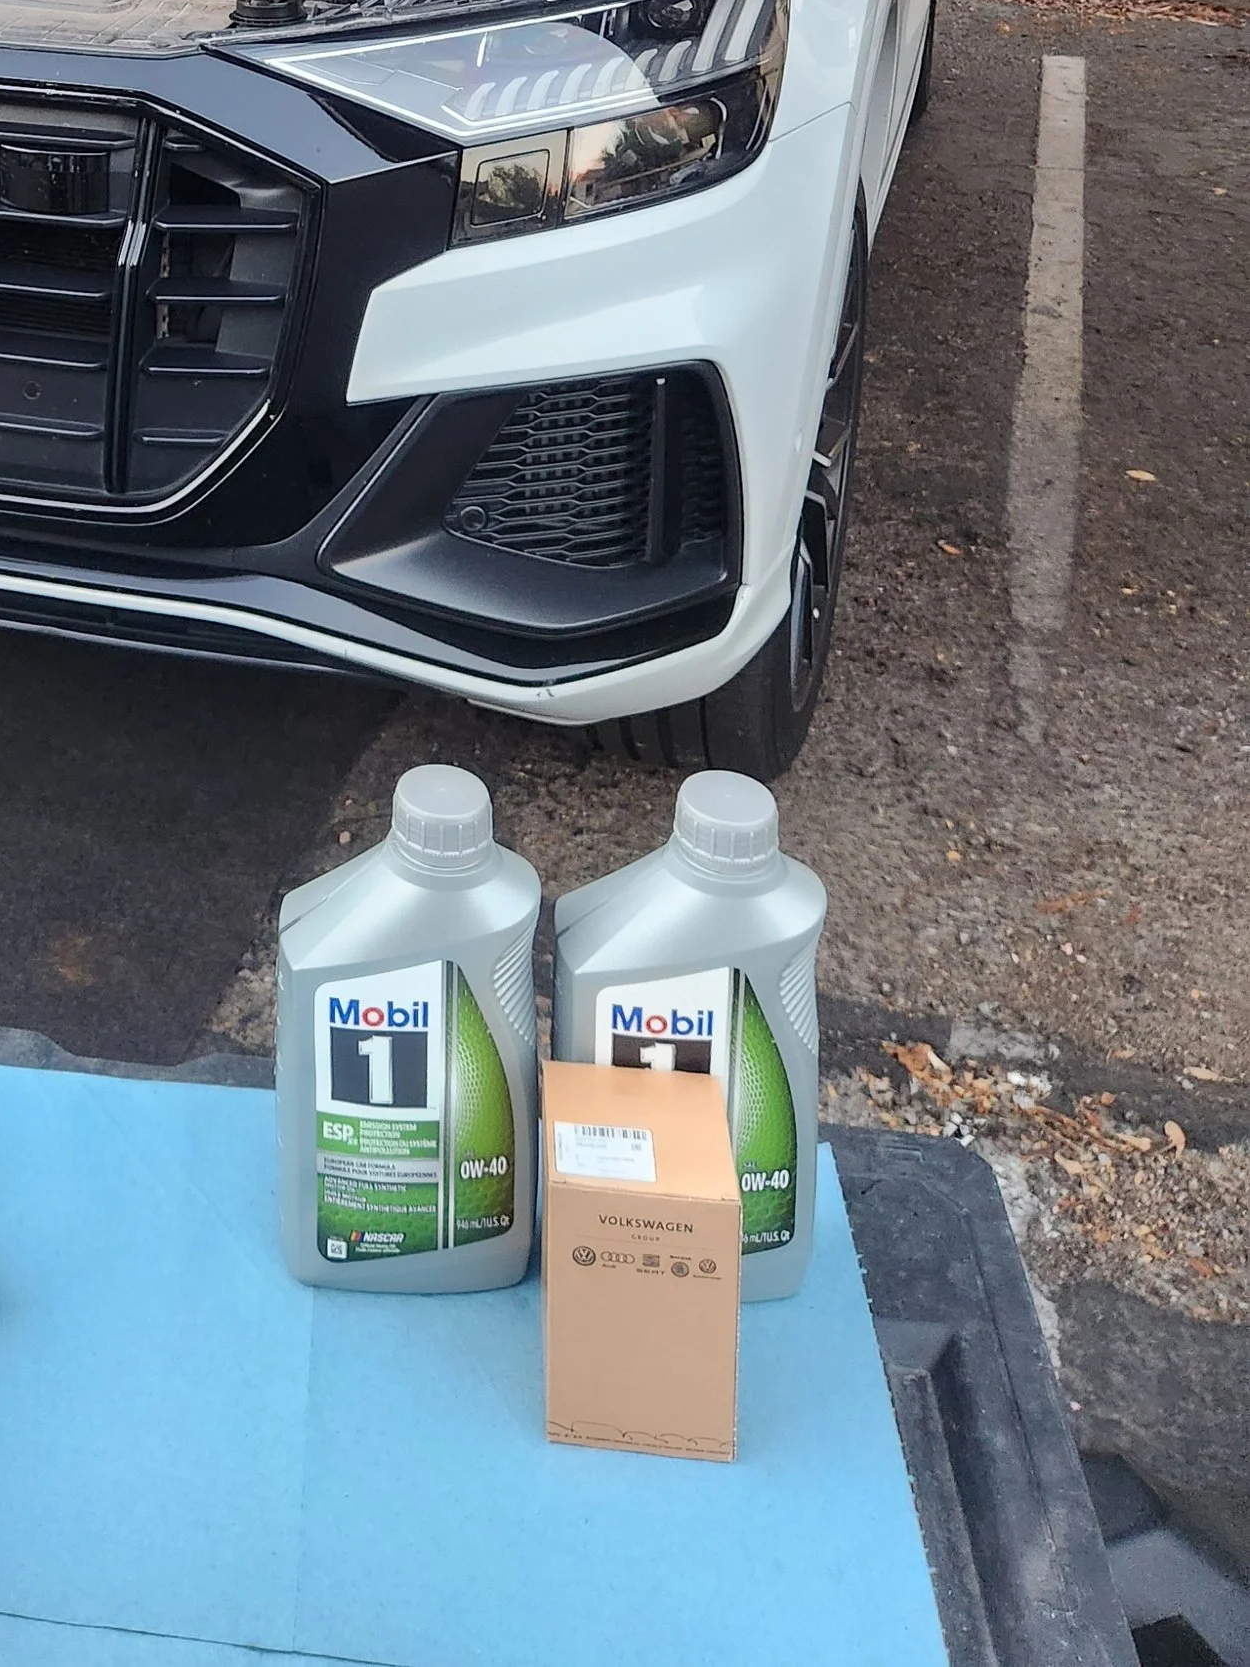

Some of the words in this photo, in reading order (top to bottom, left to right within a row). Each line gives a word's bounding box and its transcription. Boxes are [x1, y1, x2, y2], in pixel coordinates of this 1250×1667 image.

[329, 997, 429, 1028] Mobil
[611, 1003, 714, 1036] Mobil
[358, 1035, 394, 1105] 1
[323, 1120, 355, 1142] ESP
[460, 1155, 508, 1180] 0W-40
[741, 1169, 790, 1192] 0W-40
[598, 1214, 694, 1233] VOLKSWAGEN
[363, 1231, 404, 1243] NASCAR
